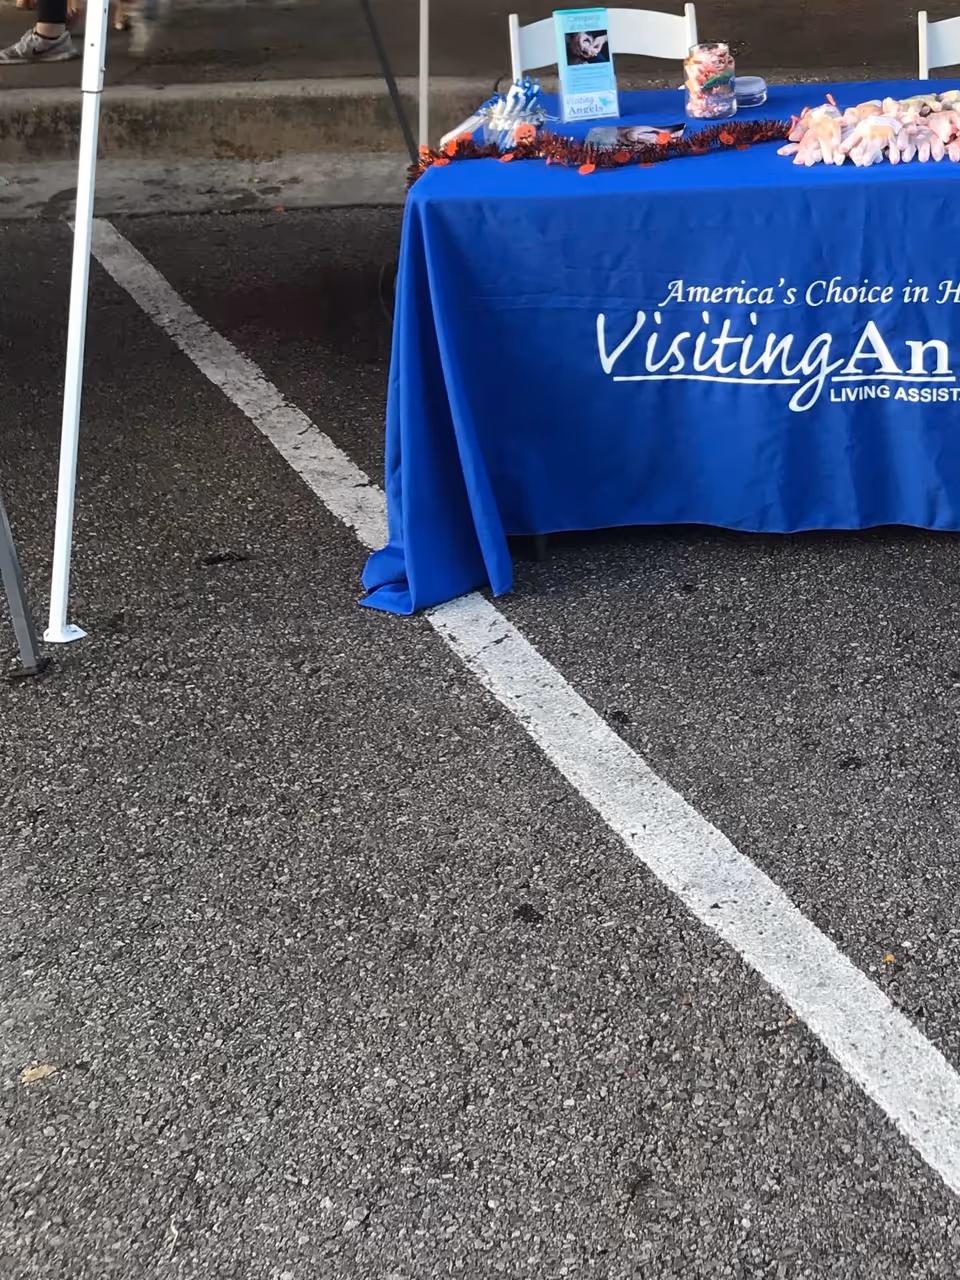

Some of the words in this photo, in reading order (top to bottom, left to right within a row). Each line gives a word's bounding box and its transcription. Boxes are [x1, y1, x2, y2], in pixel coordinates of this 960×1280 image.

[569, 104, 604, 116] Angels
[658, 278, 796, 307] America's
[805, 276, 893, 307] Choice
[903, 278, 929, 304] in
[596, 310, 844, 412] Visiting
[830, 385, 890, 402] LIVING
